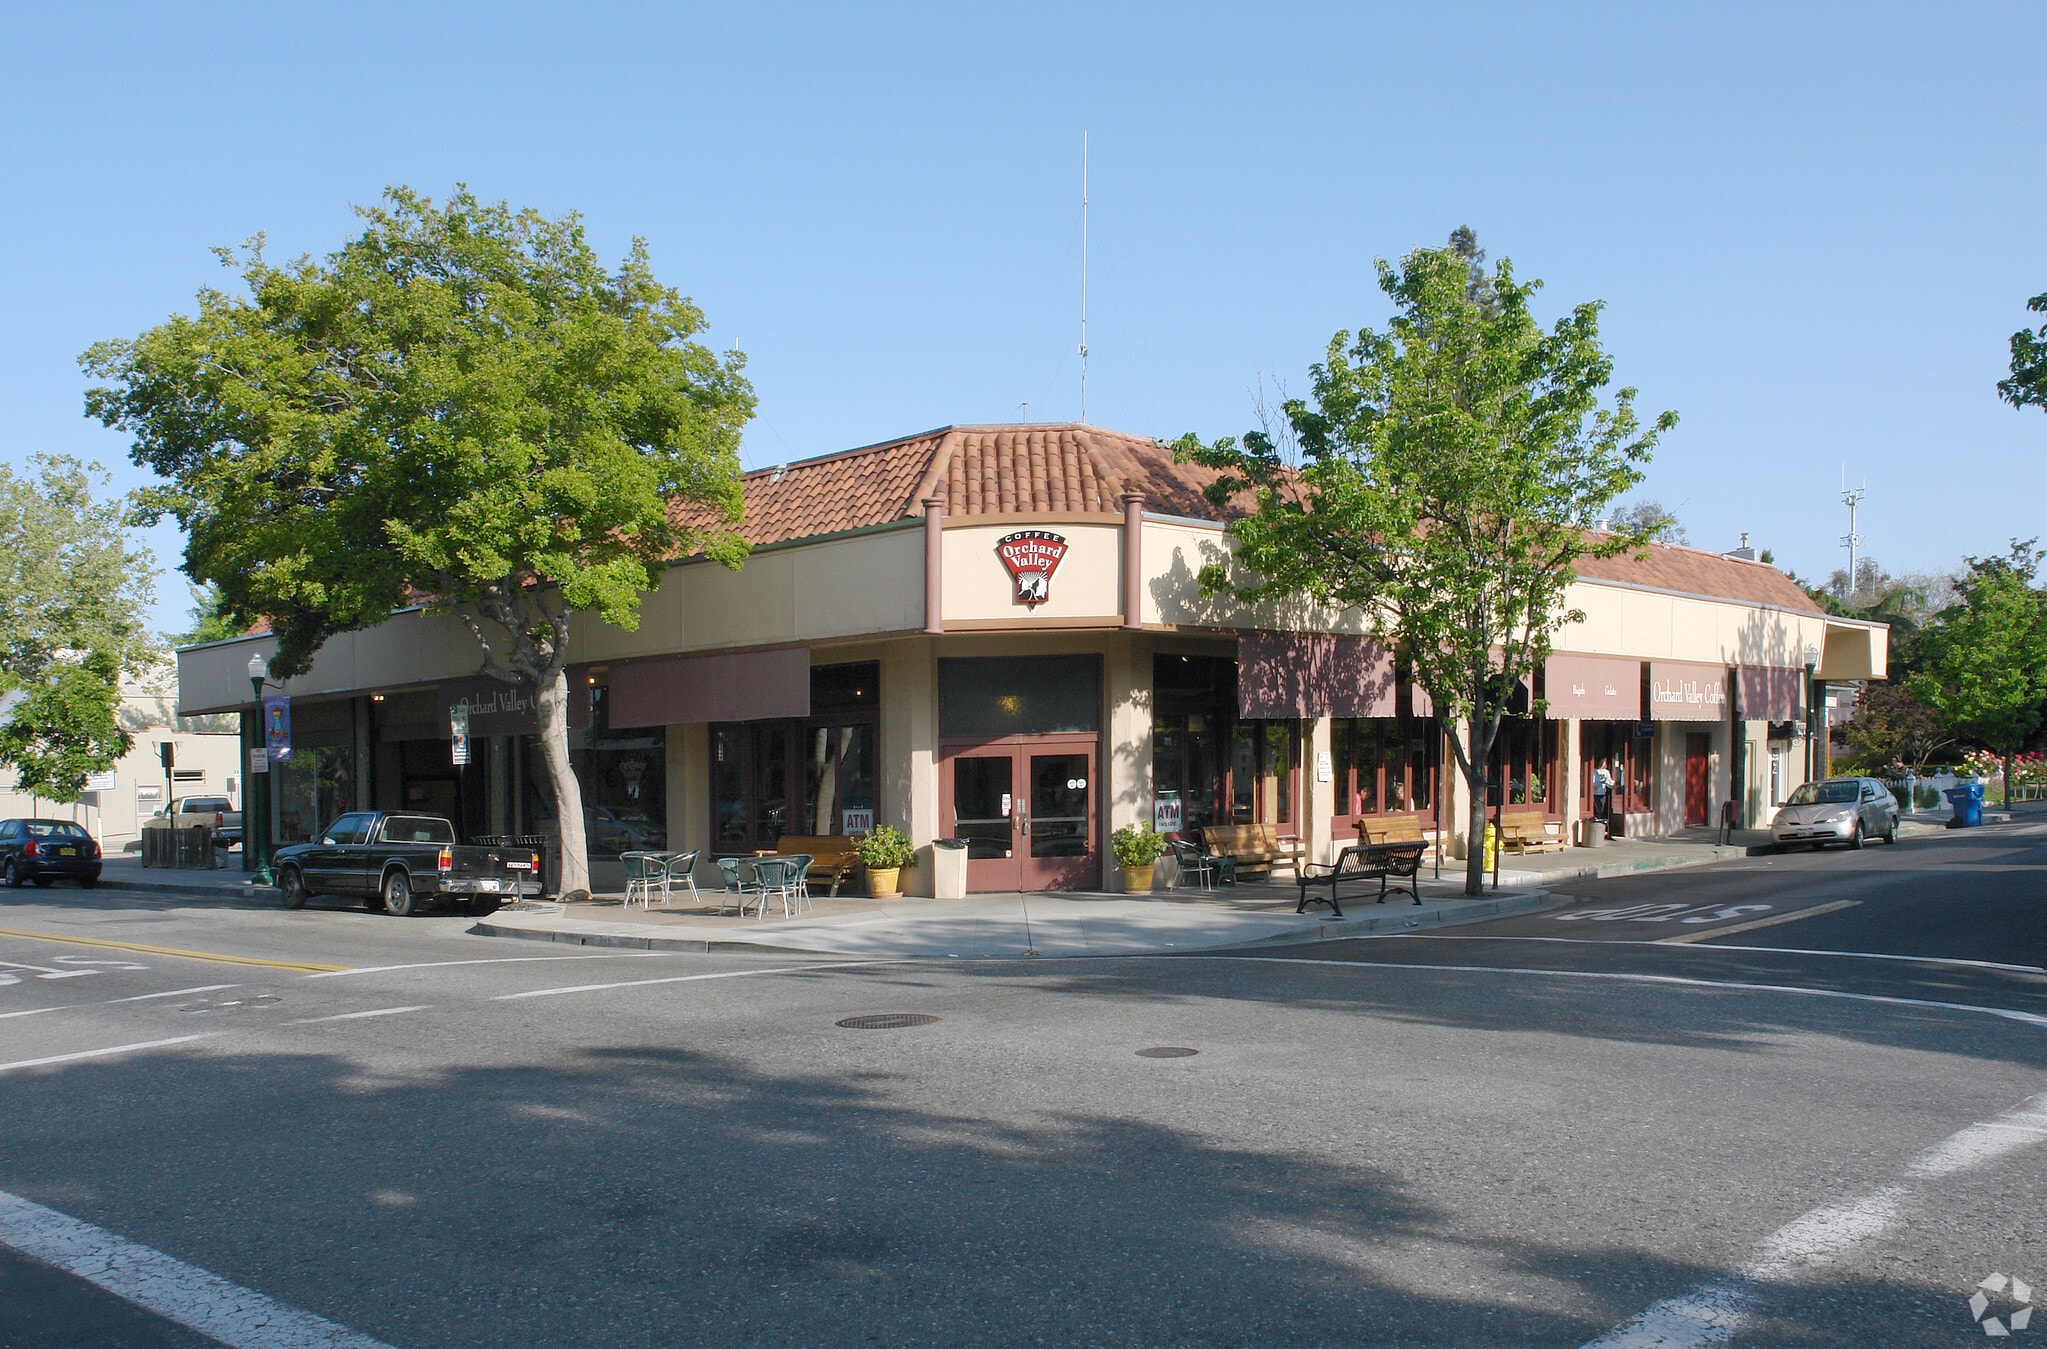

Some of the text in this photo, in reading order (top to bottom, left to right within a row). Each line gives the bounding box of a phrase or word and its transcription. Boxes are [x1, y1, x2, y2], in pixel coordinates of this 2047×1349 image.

[1004, 532, 1060, 543] COFFEE
[1002, 540, 1063, 559] Orchard
[1010, 553, 1053, 571] Valley
[499, 689, 528, 715] Valley
[1653, 679, 1725, 709] Orchard Valley Coffee
[846, 814, 870, 828] ATM
[1157, 805, 1180, 819] ATM
